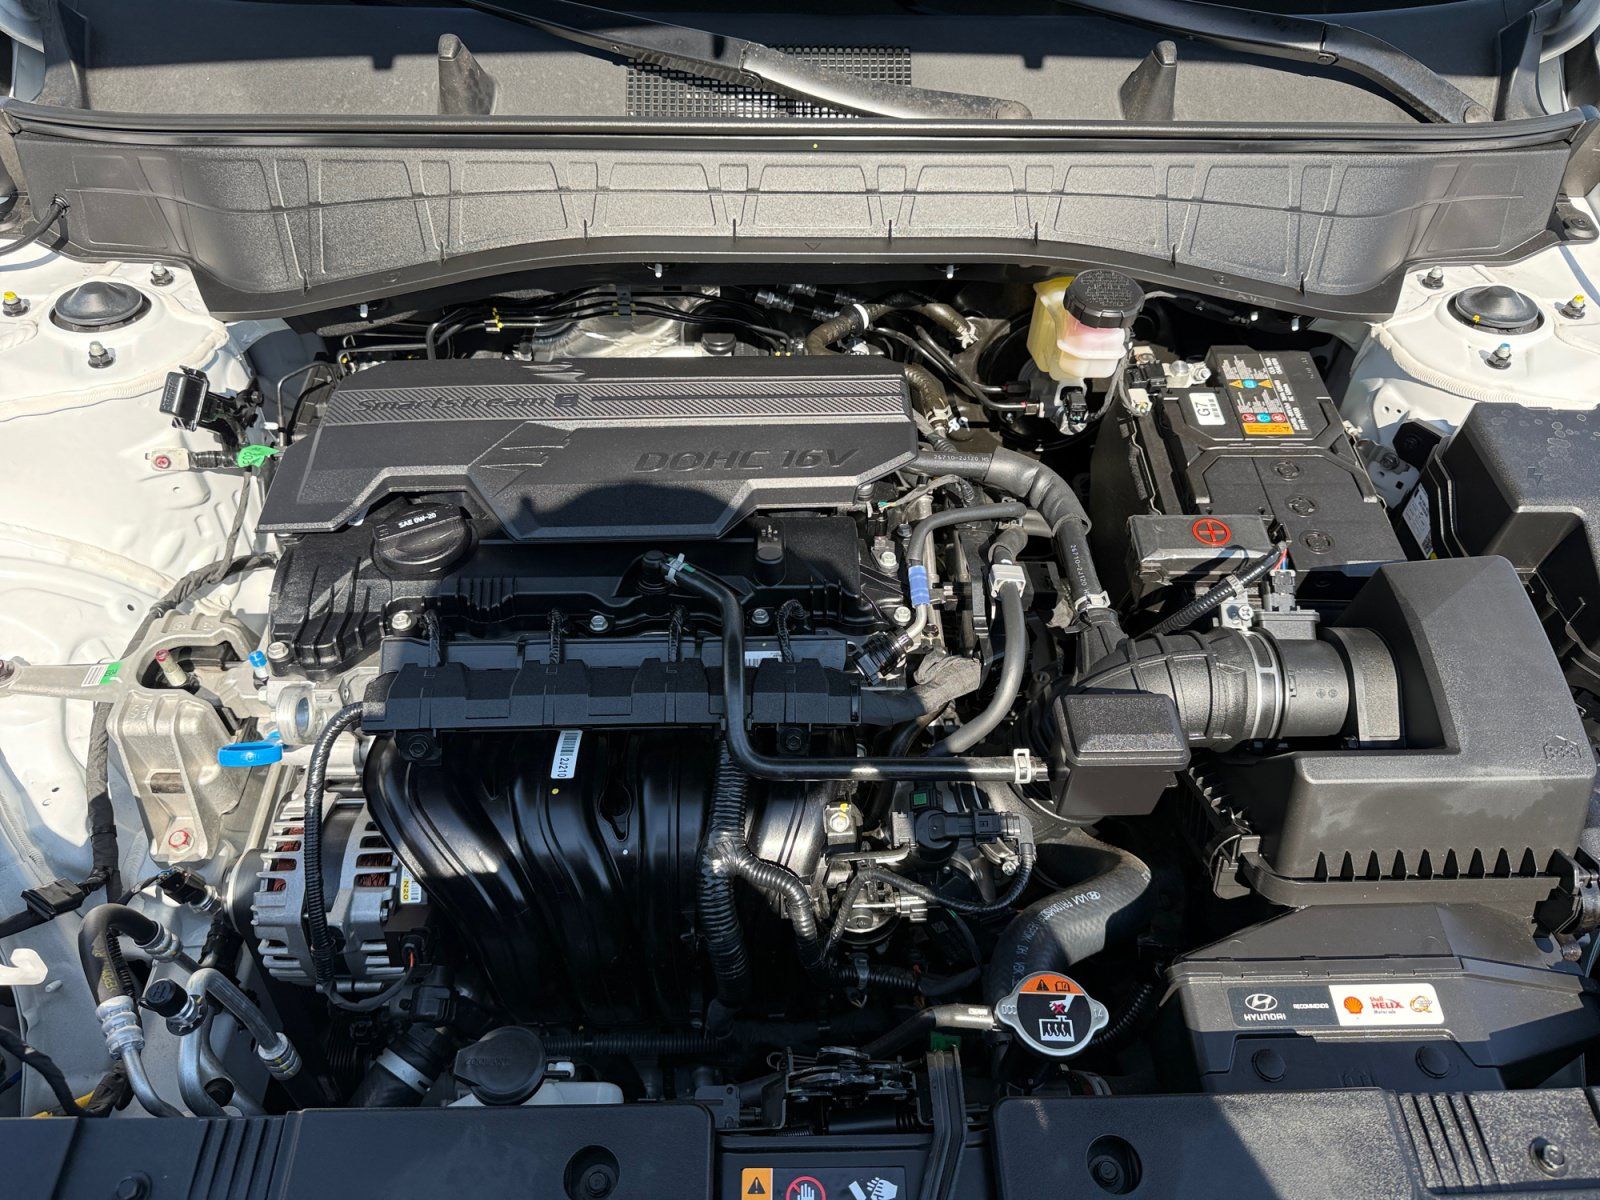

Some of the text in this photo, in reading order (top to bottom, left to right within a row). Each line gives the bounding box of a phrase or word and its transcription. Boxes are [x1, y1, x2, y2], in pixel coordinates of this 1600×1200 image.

[1195, 402, 1211, 416] G7
[633, 448, 859, 472] DOHC 16V
[1372, 1000, 1404, 1009] HELIX
[1244, 1013, 1287, 1021] HYUNDAI
